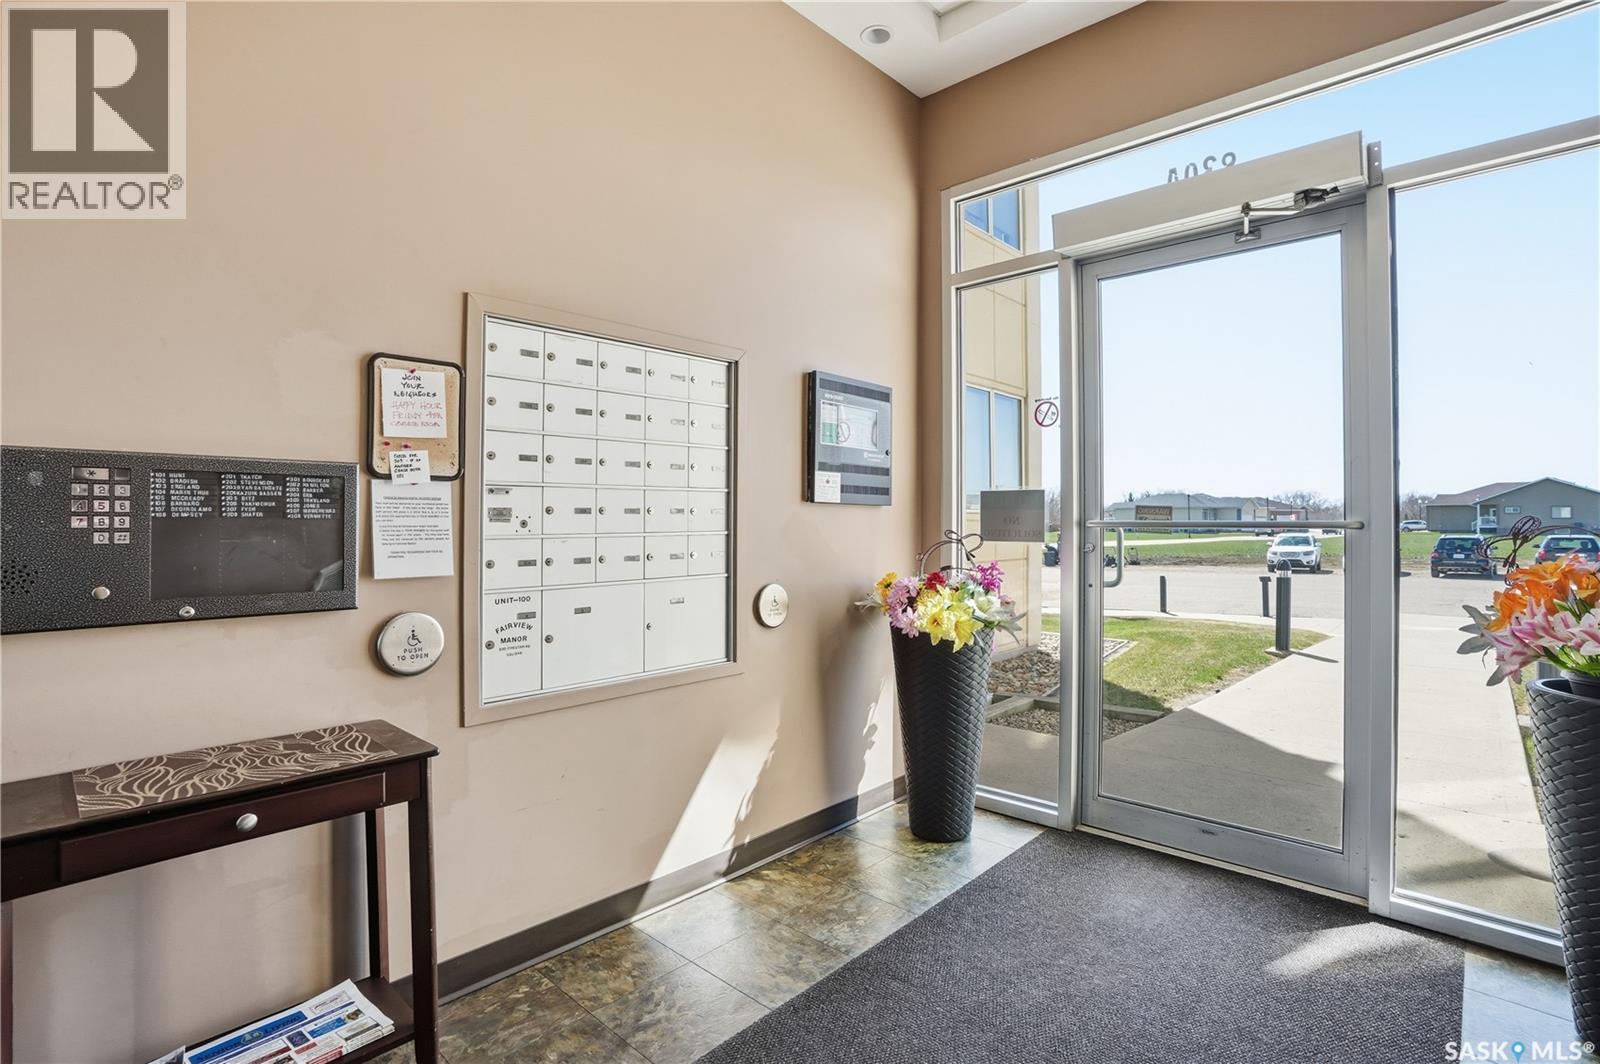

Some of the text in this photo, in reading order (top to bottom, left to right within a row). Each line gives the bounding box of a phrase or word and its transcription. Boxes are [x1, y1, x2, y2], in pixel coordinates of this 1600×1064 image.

[392, 400, 442, 410] HAPPY HOUR
[98, 486, 105, 494] 2
[98, 502, 105, 510] 5
[98, 518, 105, 526] 8
[119, 518, 125, 526] 9
[494, 596, 531, 605] UNIT-100
[495, 622, 533, 634] FAIRVIEW
[500, 635, 527, 644] MANOR
